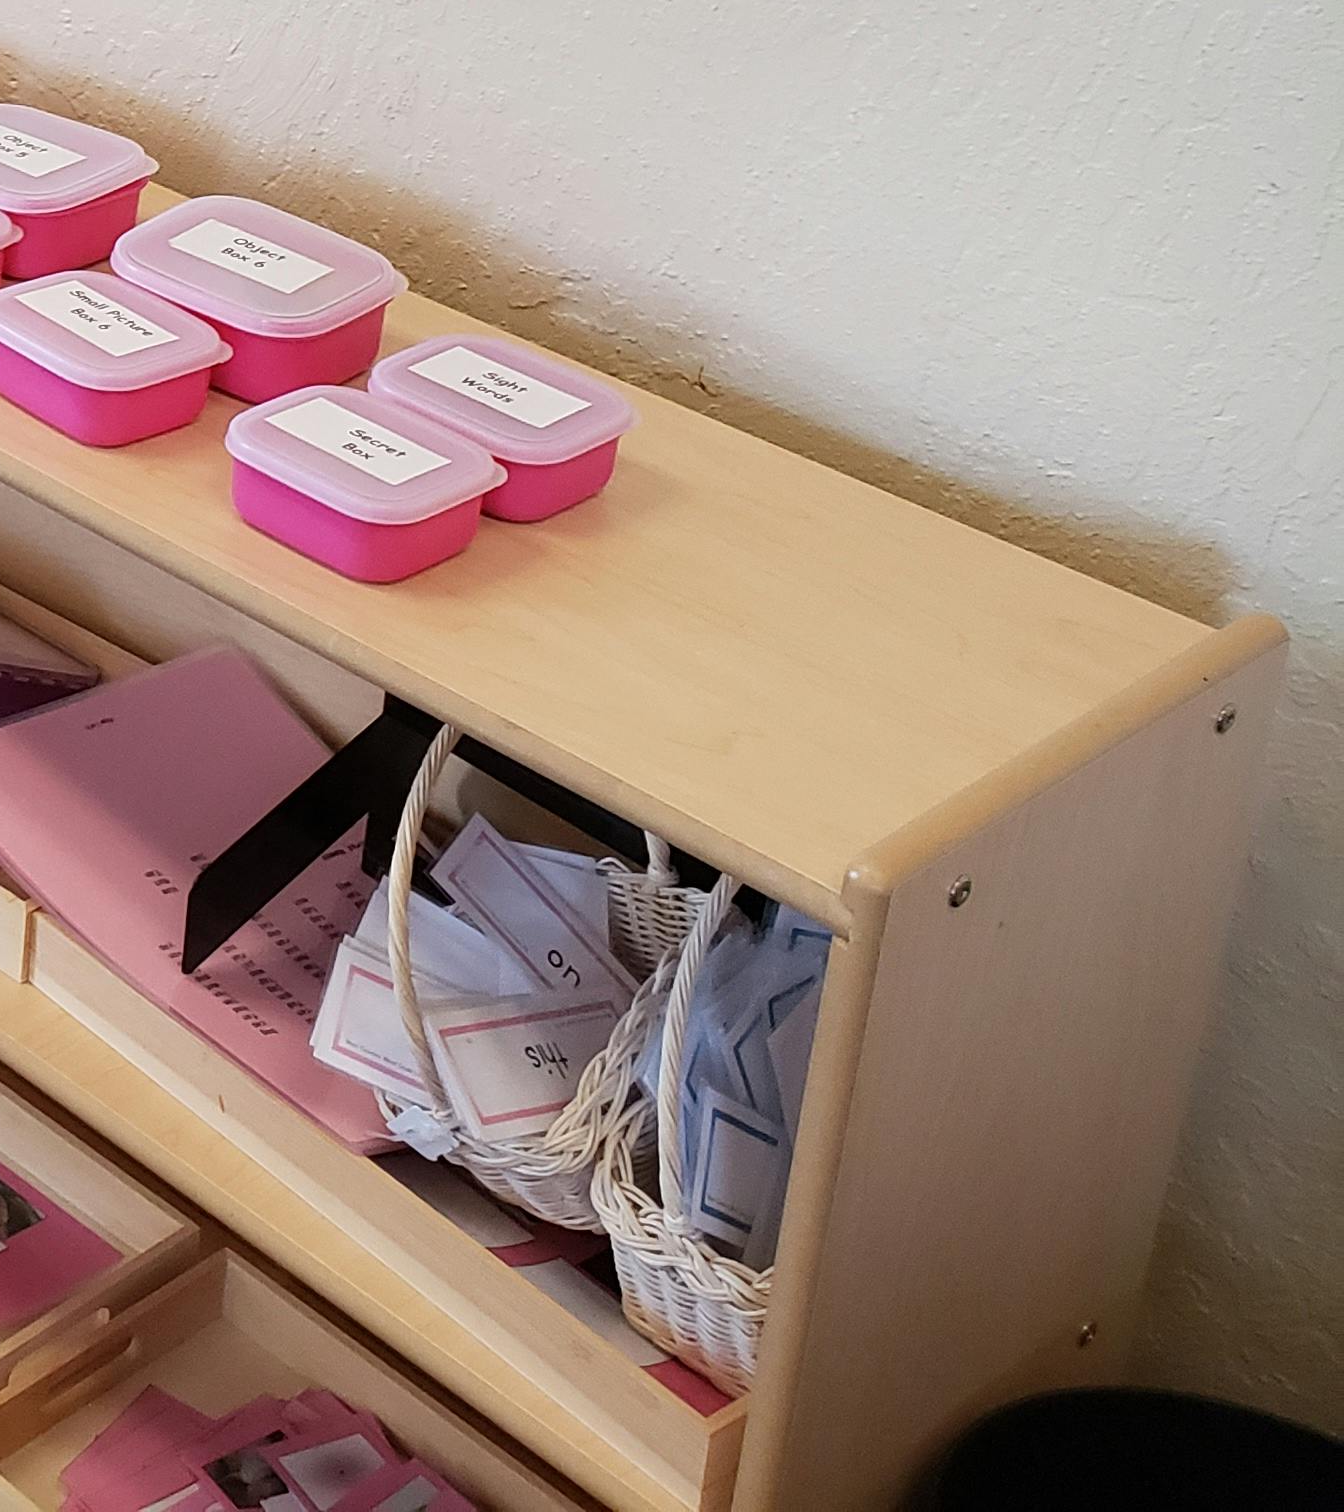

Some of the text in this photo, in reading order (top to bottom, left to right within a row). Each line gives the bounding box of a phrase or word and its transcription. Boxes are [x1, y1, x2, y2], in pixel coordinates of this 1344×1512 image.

[3, 134, 49, 154] Object
[16, 150, 29, 159] 5
[220, 246, 266, 269] Box 6
[232, 237, 287, 261] Object
[69, 289, 155, 337] Small Picture
[70, 308, 111, 331] Box 6
[461, 375, 514, 405] Words
[481, 372, 528, 395] Sight
[341, 442, 375, 461] Box
[349, 428, 408, 459] Secret
[547, 949, 582, 989] on
[524, 1041, 569, 1080] this
